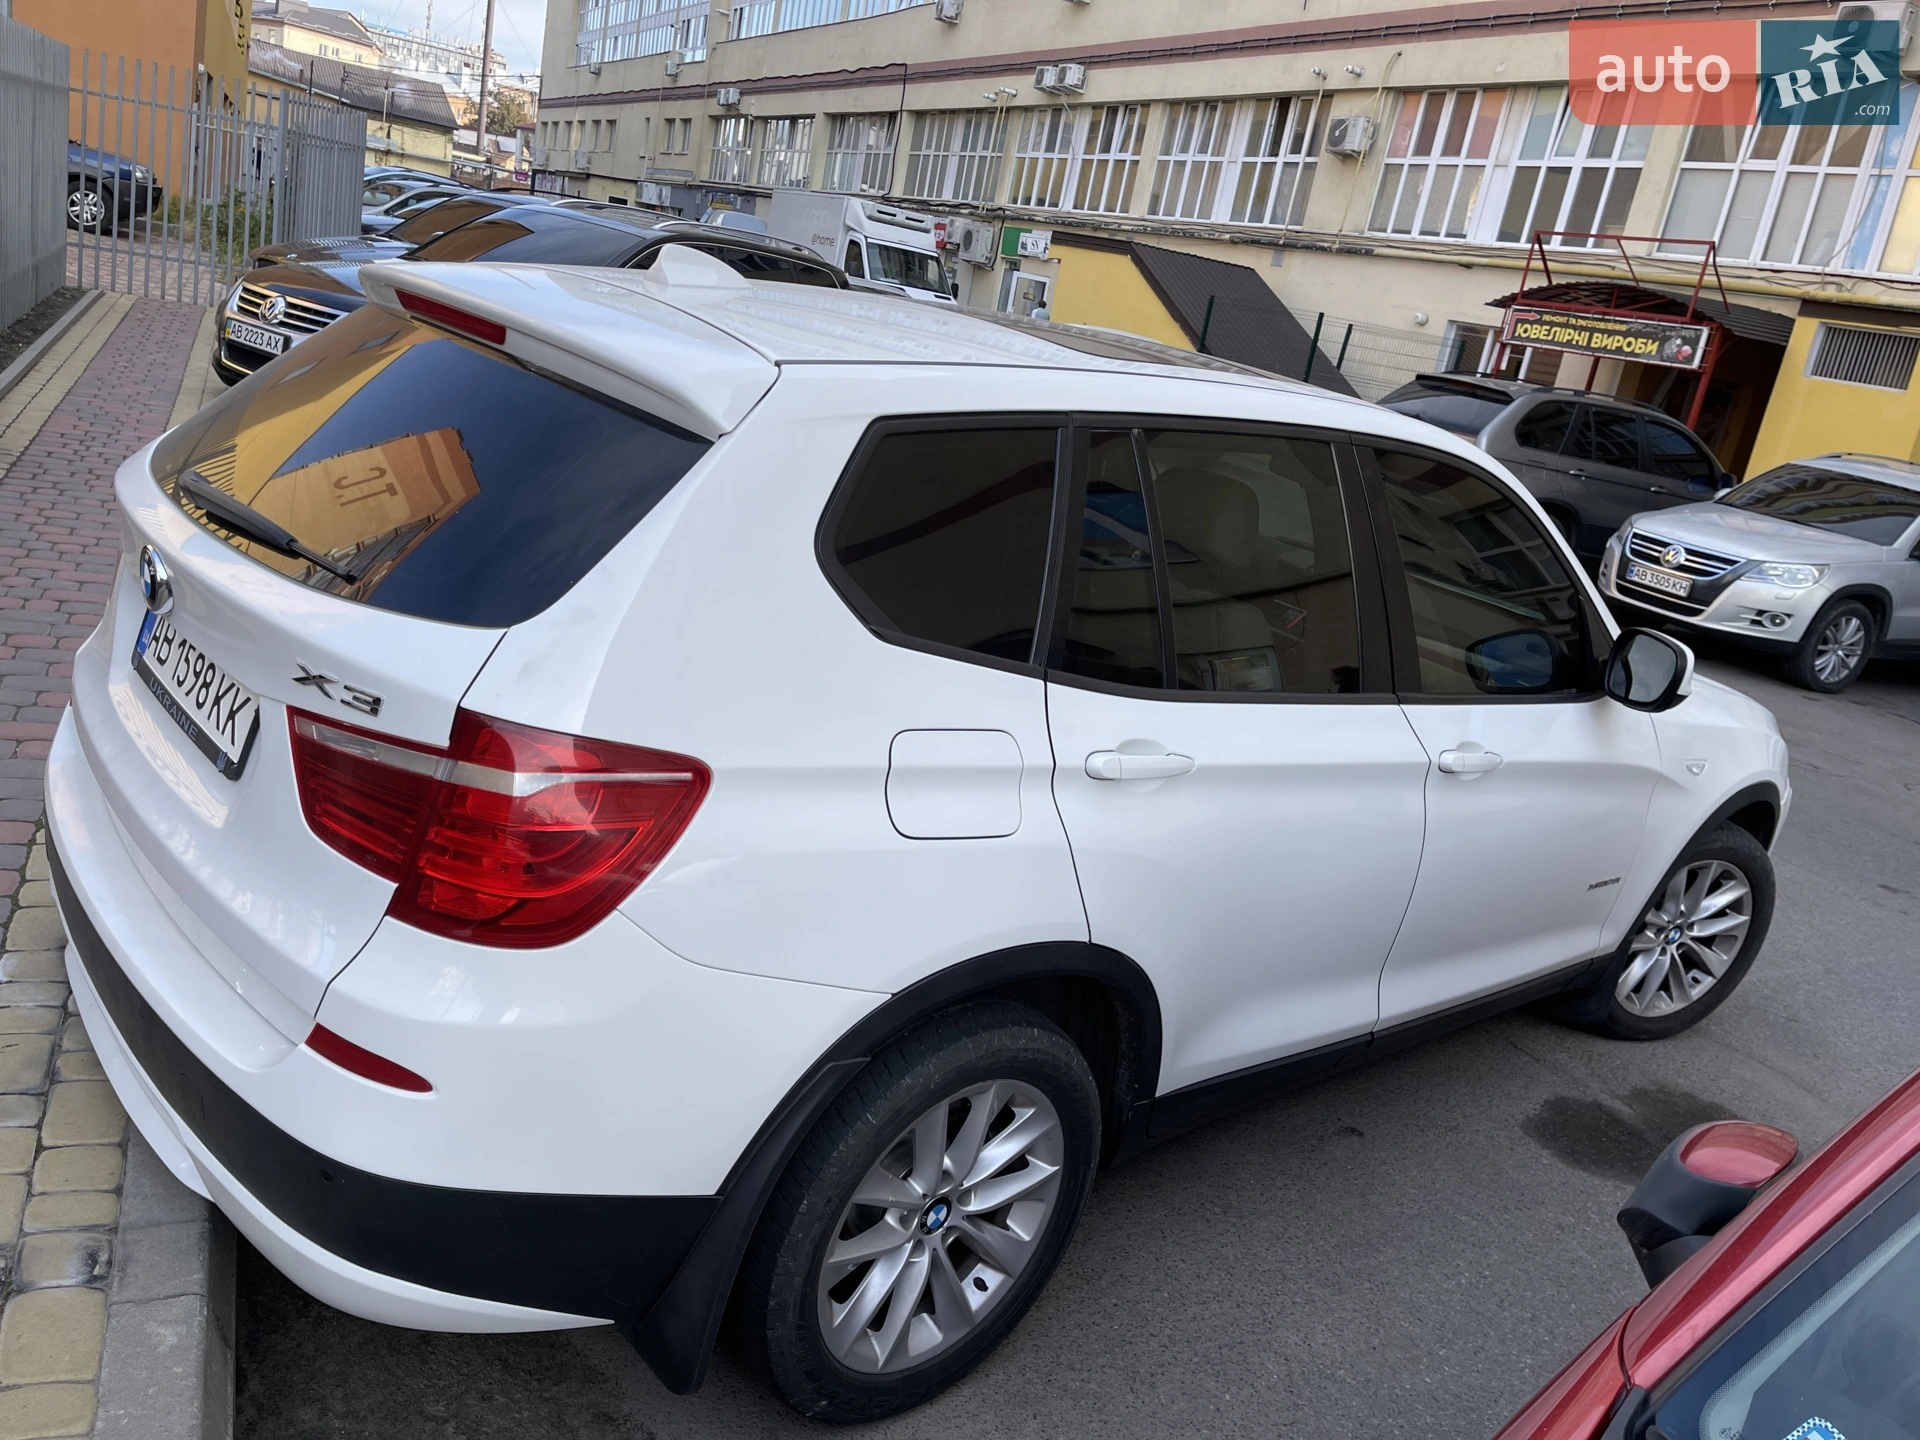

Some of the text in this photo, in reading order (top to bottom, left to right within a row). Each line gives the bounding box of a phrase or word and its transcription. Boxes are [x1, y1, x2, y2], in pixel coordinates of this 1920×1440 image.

[811, 232, 835, 247] @home
[1541, 314, 1569, 324] РЕМОНТ
[1568, 317, 1577, 326] ТА
[230, 323, 281, 352] AB 2223 AX
[1515, 322, 1660, 356] ЮВЕЛІРНІ ВИРОБИ
[1634, 568, 1689, 594] AB 3505 KH
[148, 616, 252, 747] AB 1598 KK
[291, 659, 386, 718] X3
[149, 676, 199, 742] UKRAINE
